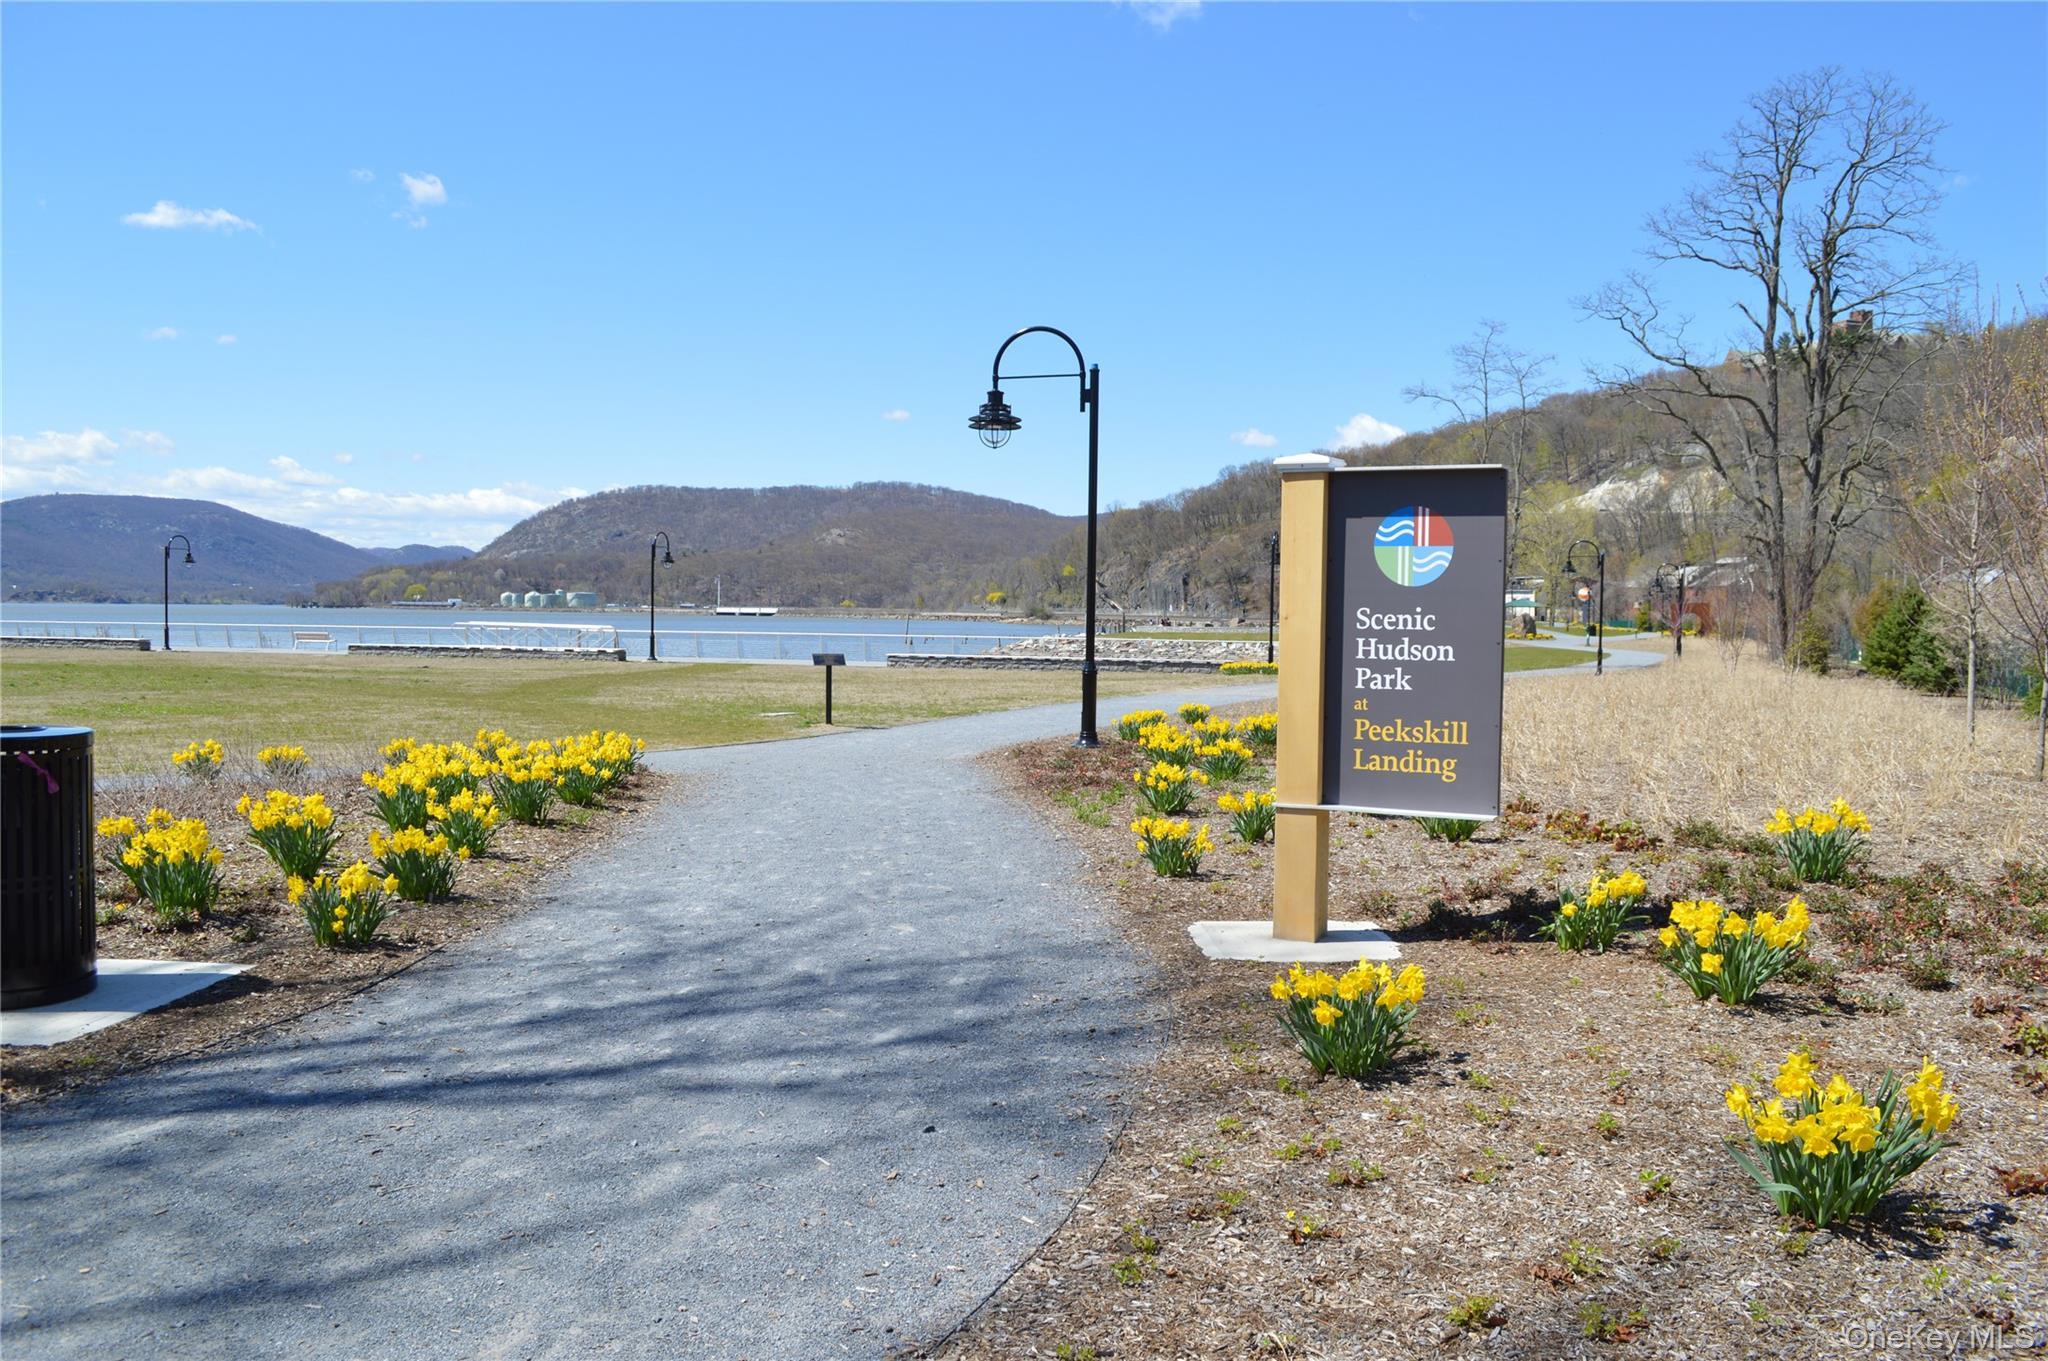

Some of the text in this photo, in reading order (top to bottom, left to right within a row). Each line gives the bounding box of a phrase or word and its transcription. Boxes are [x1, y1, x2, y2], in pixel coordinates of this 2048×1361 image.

[1356, 607, 1436, 631] Scenic
[1355, 637, 1456, 662] Hudson
[1354, 667, 1413, 691] Park
[1353, 698, 1368, 711] at
[1353, 718, 1469, 745] Peekskill
[1353, 748, 1457, 782] Landing
